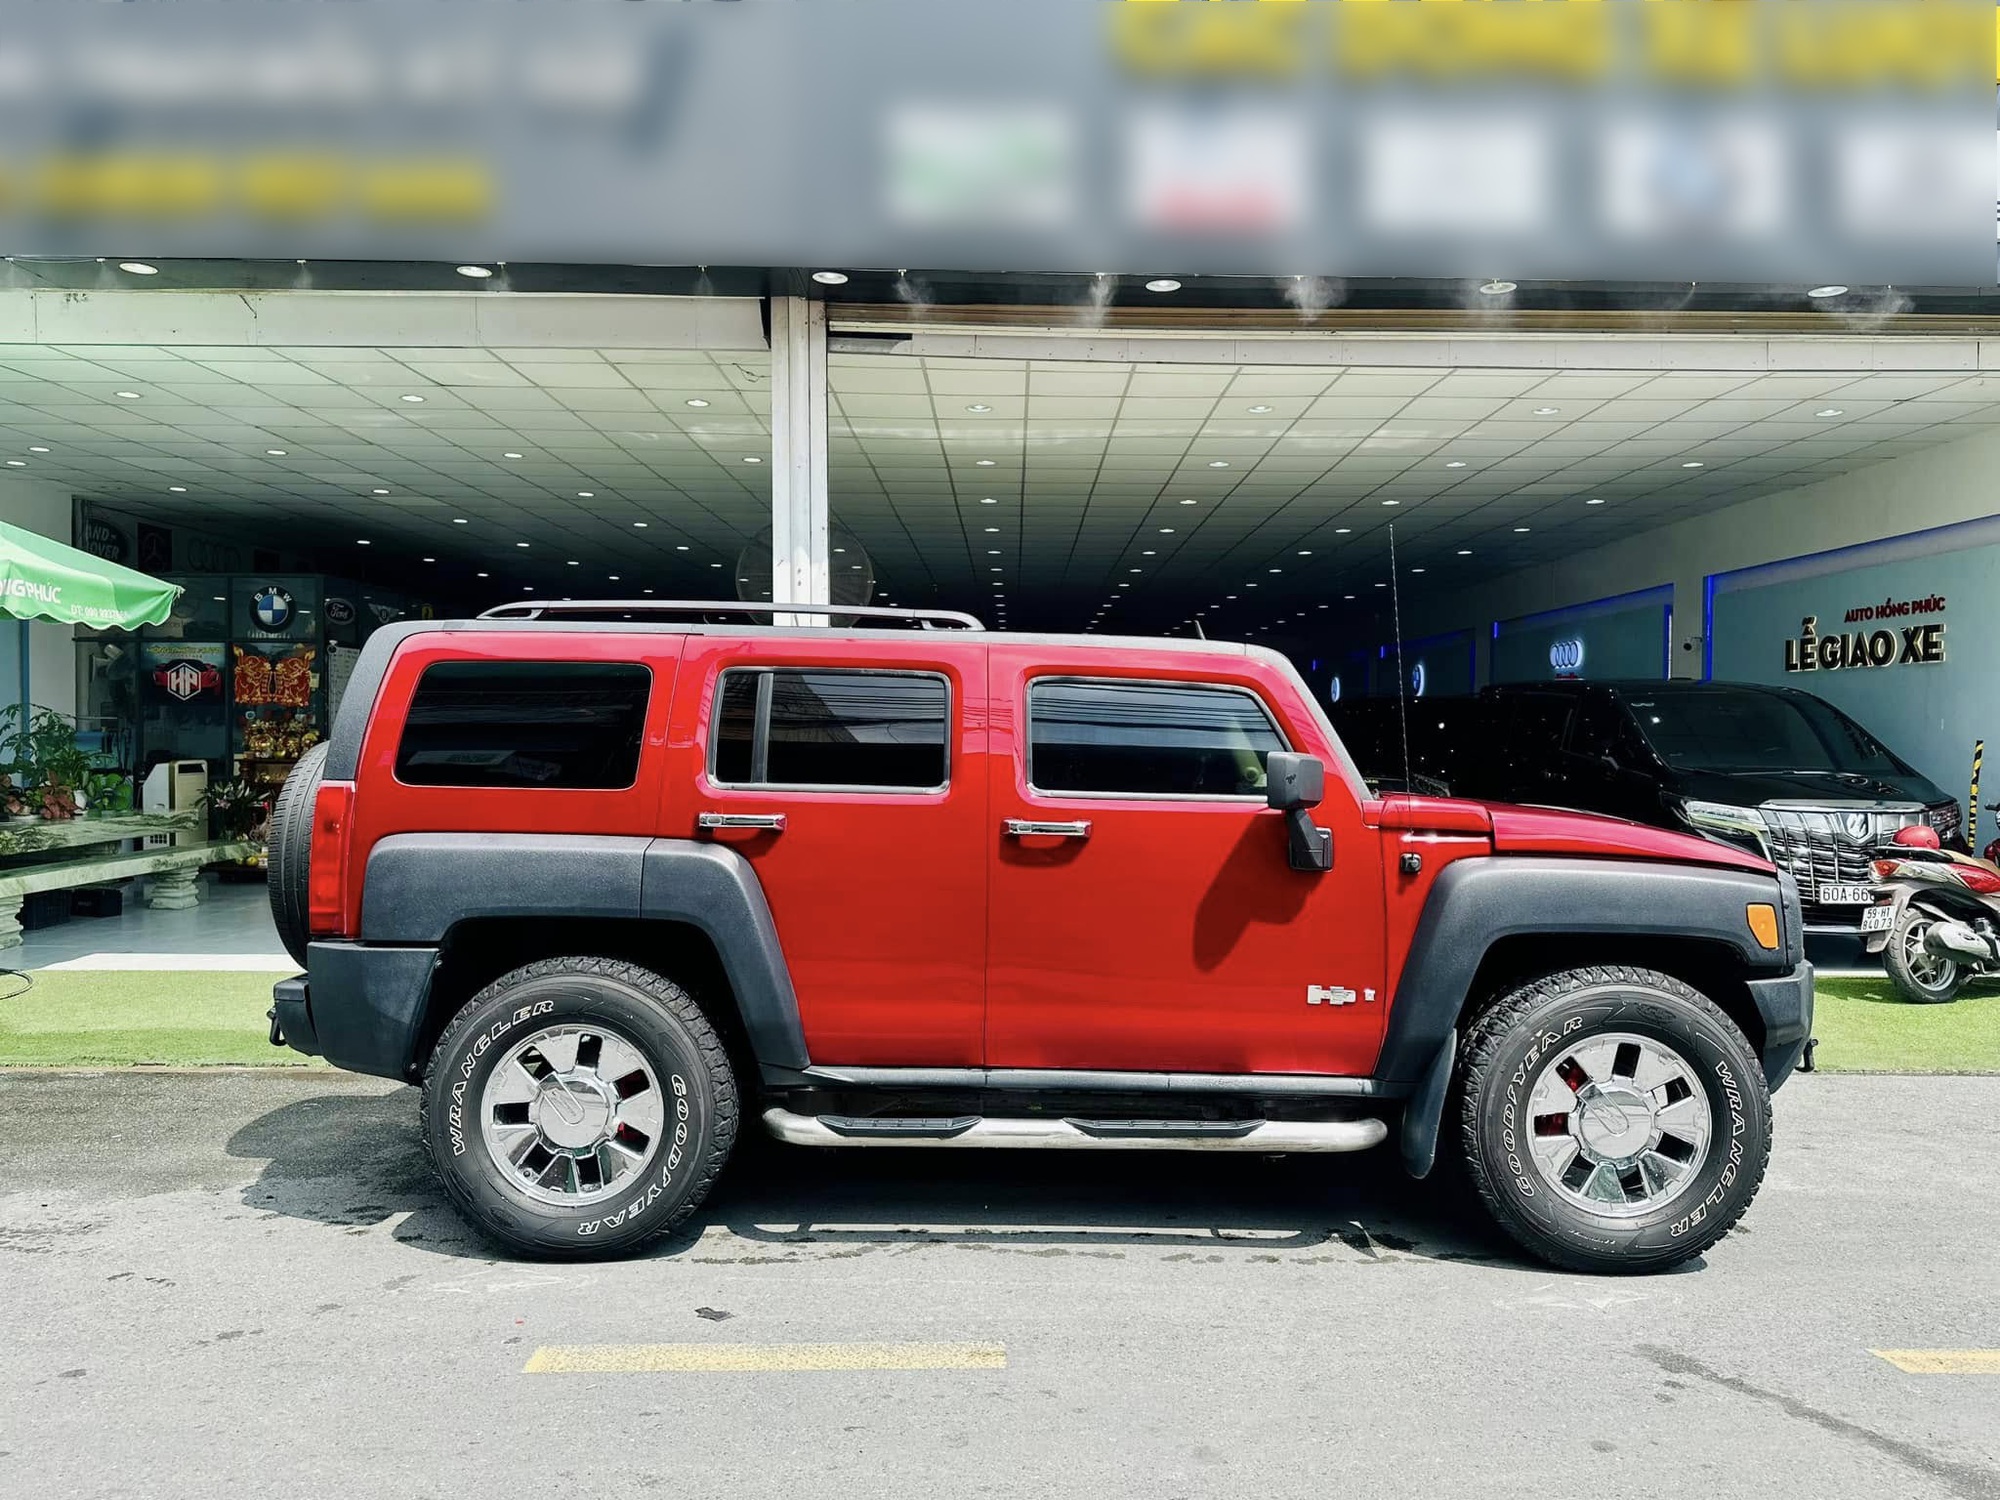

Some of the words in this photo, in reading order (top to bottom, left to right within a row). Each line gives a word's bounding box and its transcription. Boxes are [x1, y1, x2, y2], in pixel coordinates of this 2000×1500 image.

[86, 541, 120, 560] OVER
[1844, 606, 1874, 623] AUTO
[1911, 594, 1946, 615] PHÚC
[1898, 623, 1947, 664] XE
[449, 1000, 555, 1157] WRANGLER
[577, 1073, 689, 1236] GOODYEAR
[1502, 1016, 1583, 1198] GOODYEAR
[1670, 1060, 1746, 1238] WRANGLER
